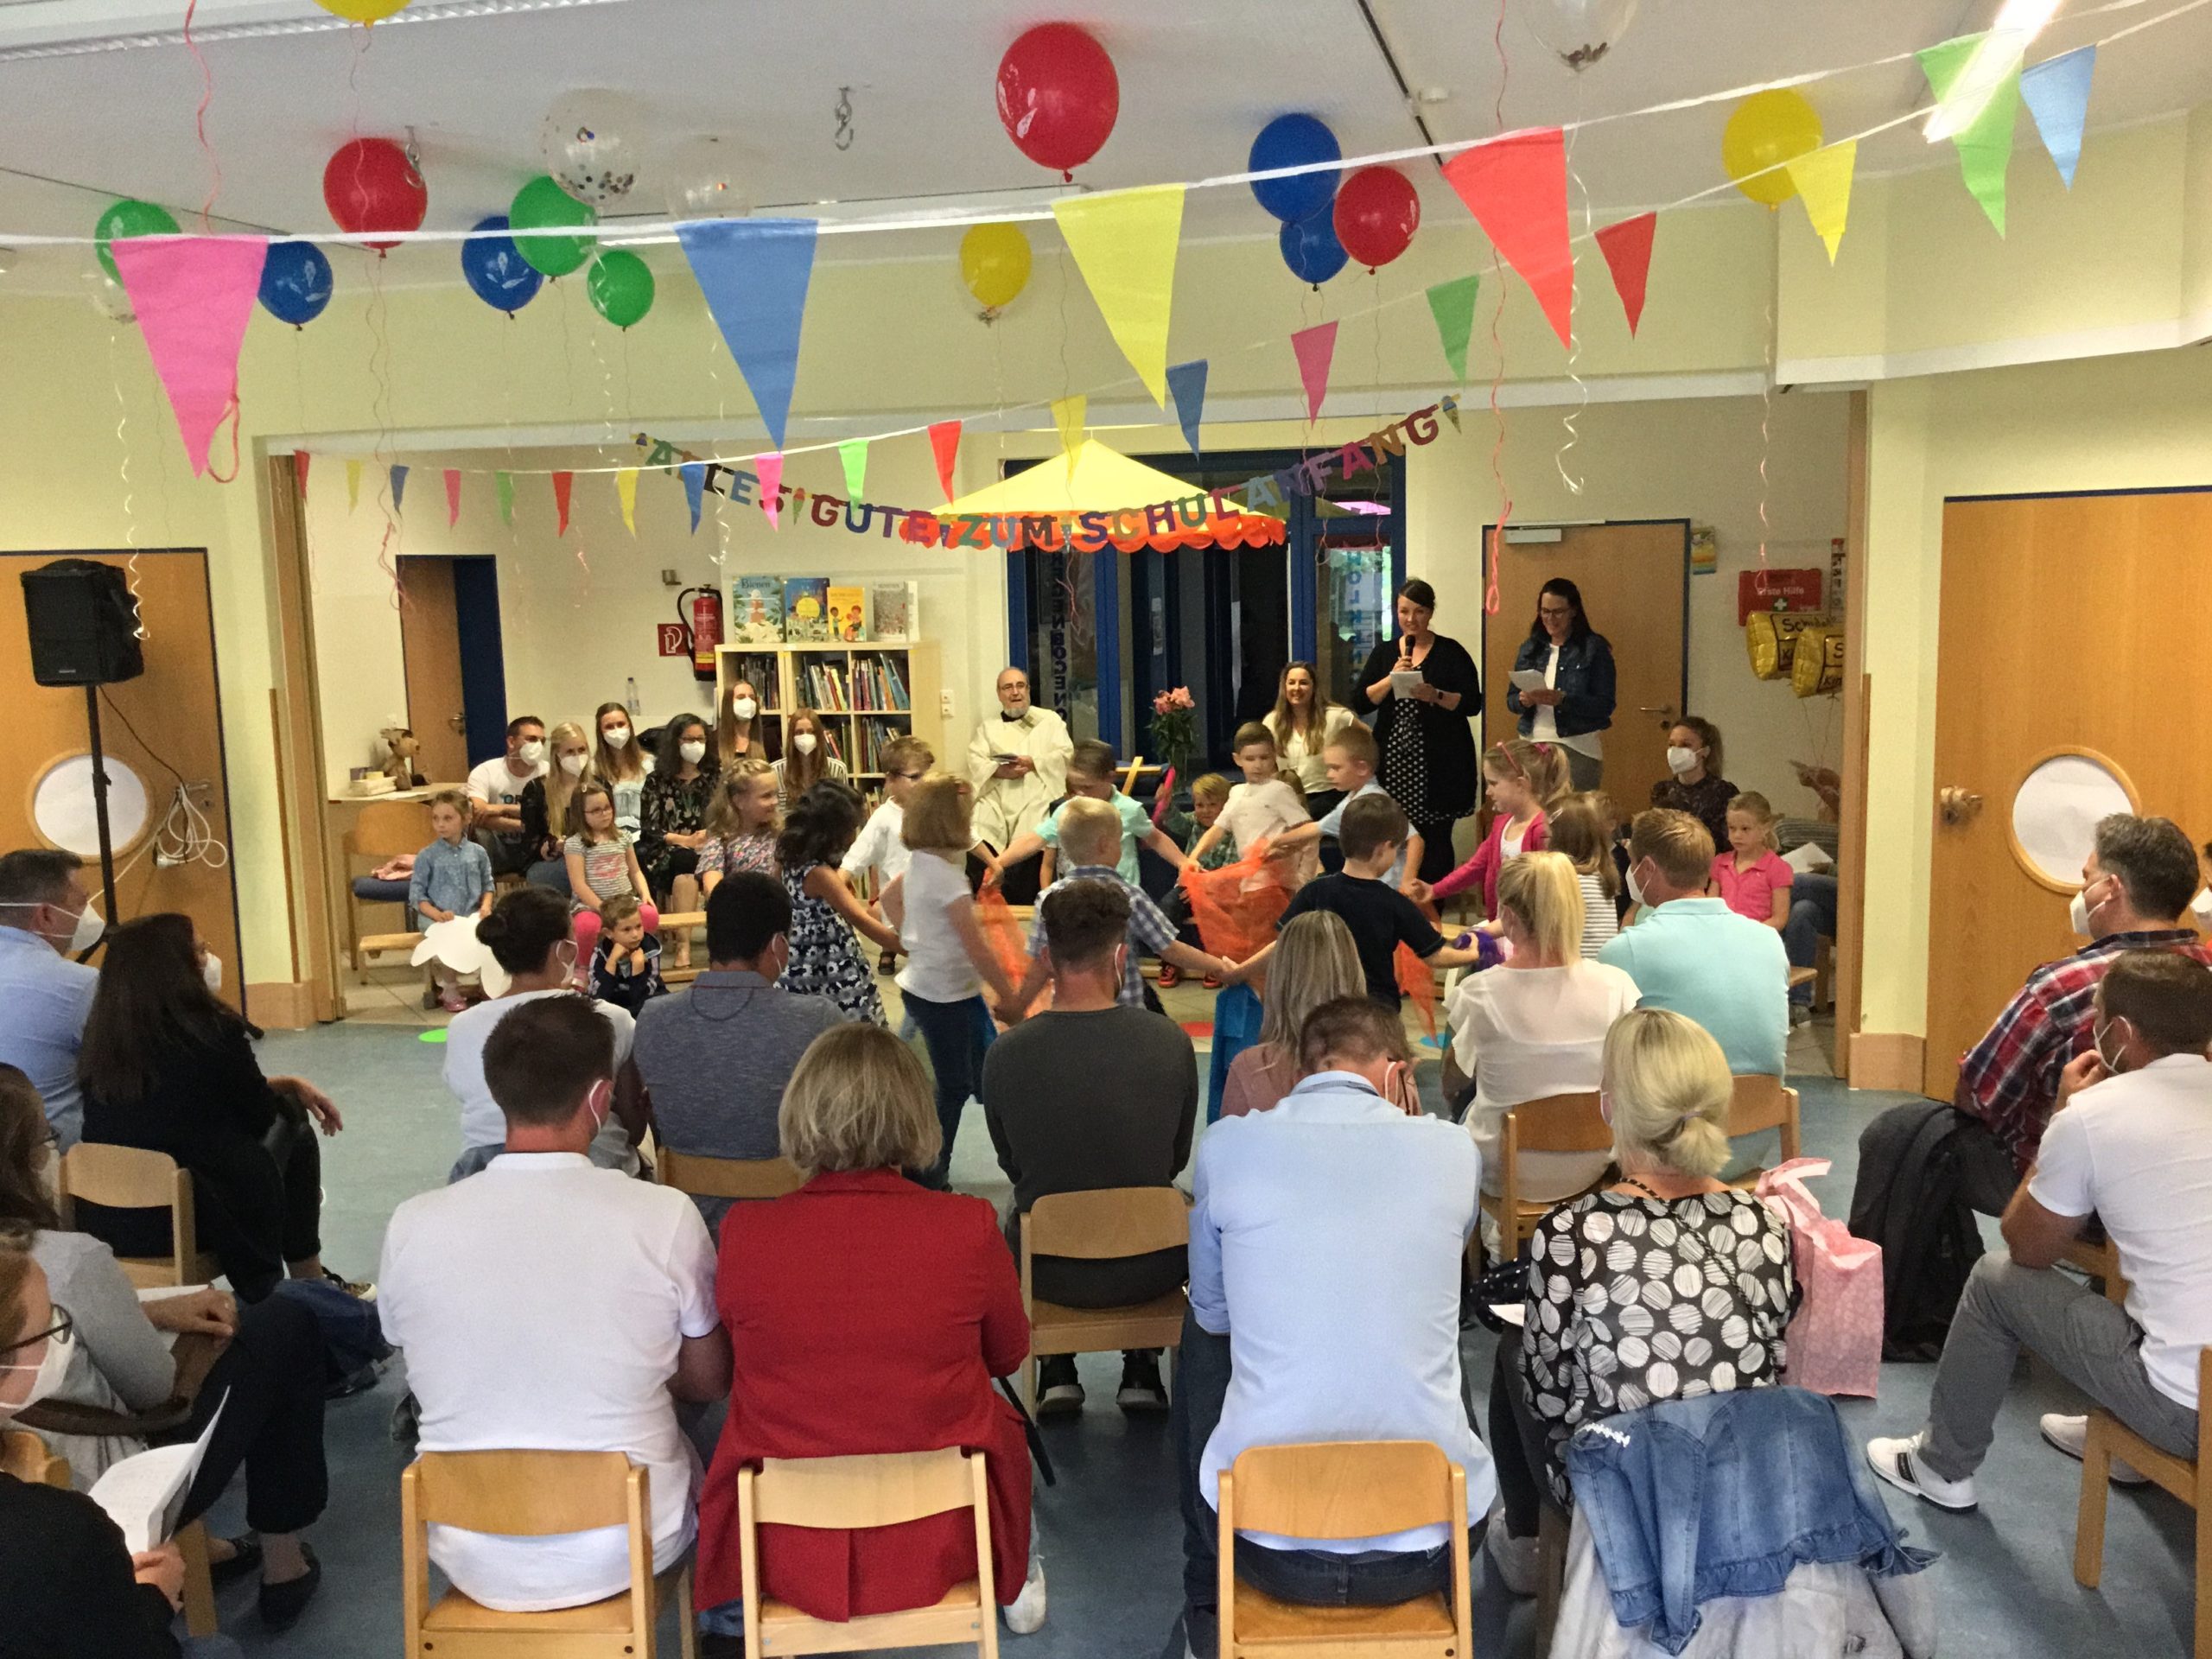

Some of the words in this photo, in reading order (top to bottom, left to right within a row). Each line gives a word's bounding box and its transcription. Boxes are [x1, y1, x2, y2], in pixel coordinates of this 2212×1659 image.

[810, 493, 931, 543] GUTE
[957, 513, 1054, 547] ZUM
[1077, 407, 1440, 544] SCHULANFANG
[741, 578, 771, 589] Bienen
[1783, 586, 1805, 594] Hilfe
